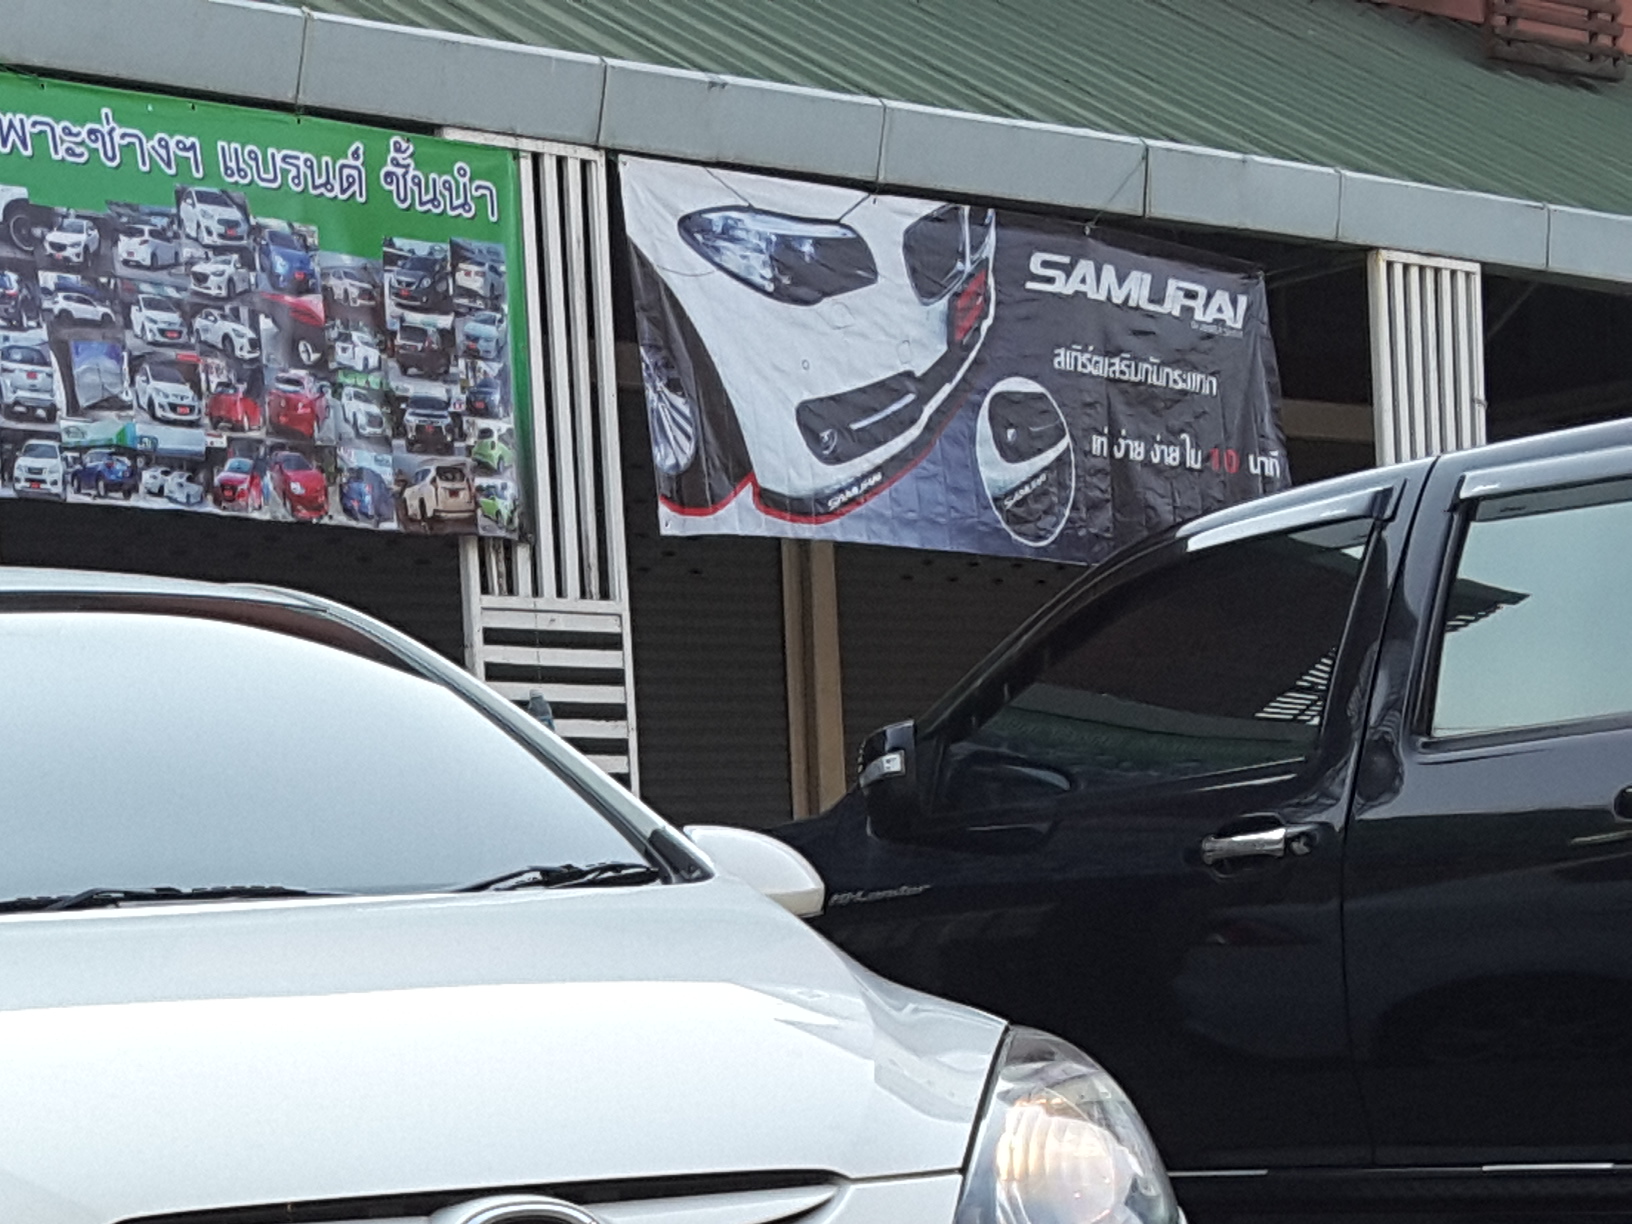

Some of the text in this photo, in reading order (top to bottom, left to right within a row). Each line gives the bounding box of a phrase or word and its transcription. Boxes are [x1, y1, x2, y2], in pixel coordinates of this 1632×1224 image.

[218, 141, 366, 203] แบรนด์
[380, 136, 498, 222] ชั้นนำ
[1025, 252, 1248, 329] SAMURAI
[1210, 447, 1240, 474] 10
